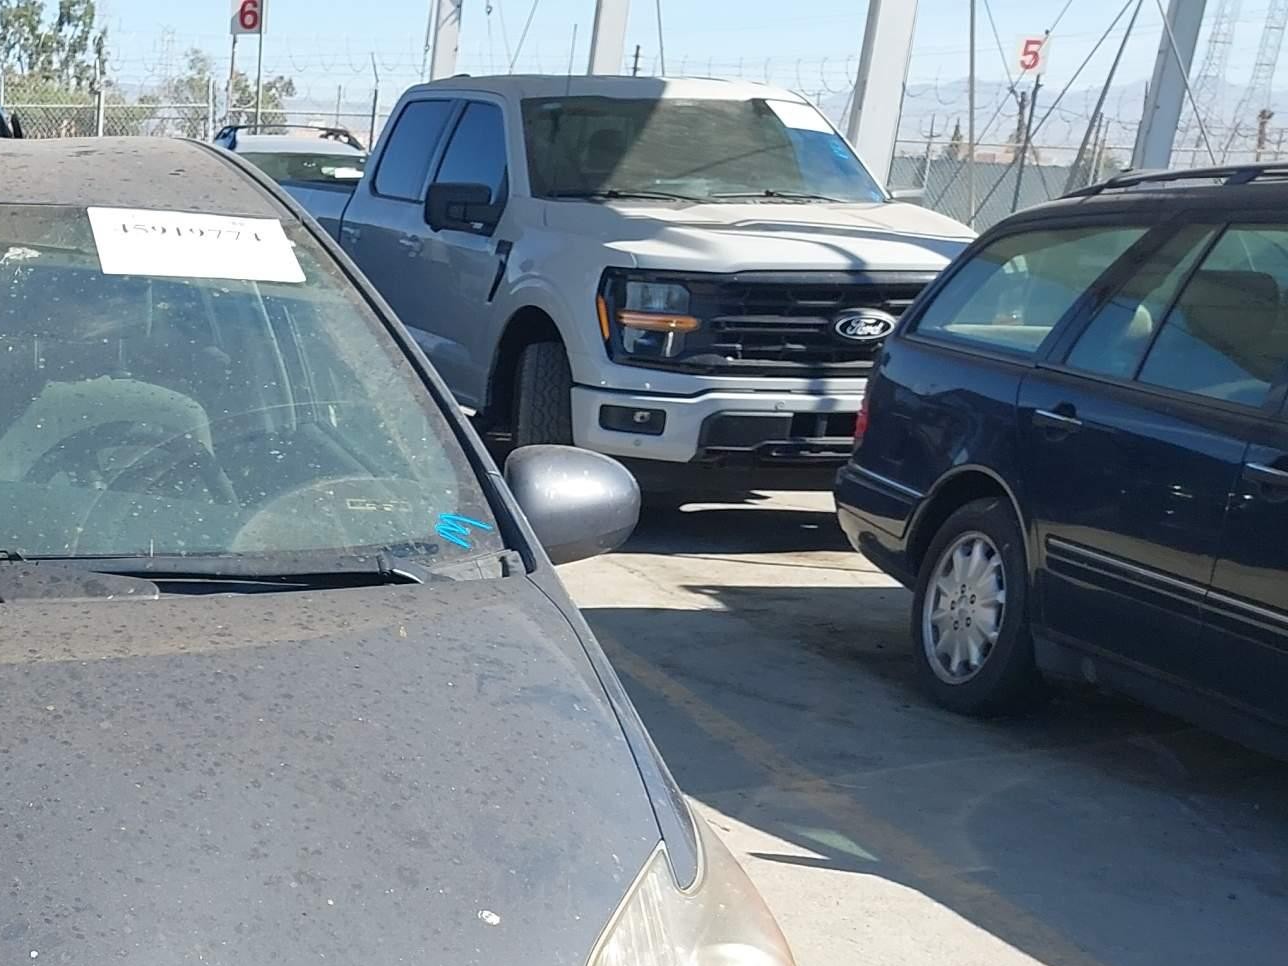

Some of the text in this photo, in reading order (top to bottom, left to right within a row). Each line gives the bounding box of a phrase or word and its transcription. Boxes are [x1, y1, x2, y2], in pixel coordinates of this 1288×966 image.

[240, 0, 258, 30] 6
[1020, 39, 1042, 69] 5
[845, 318, 884, 336] Ford
